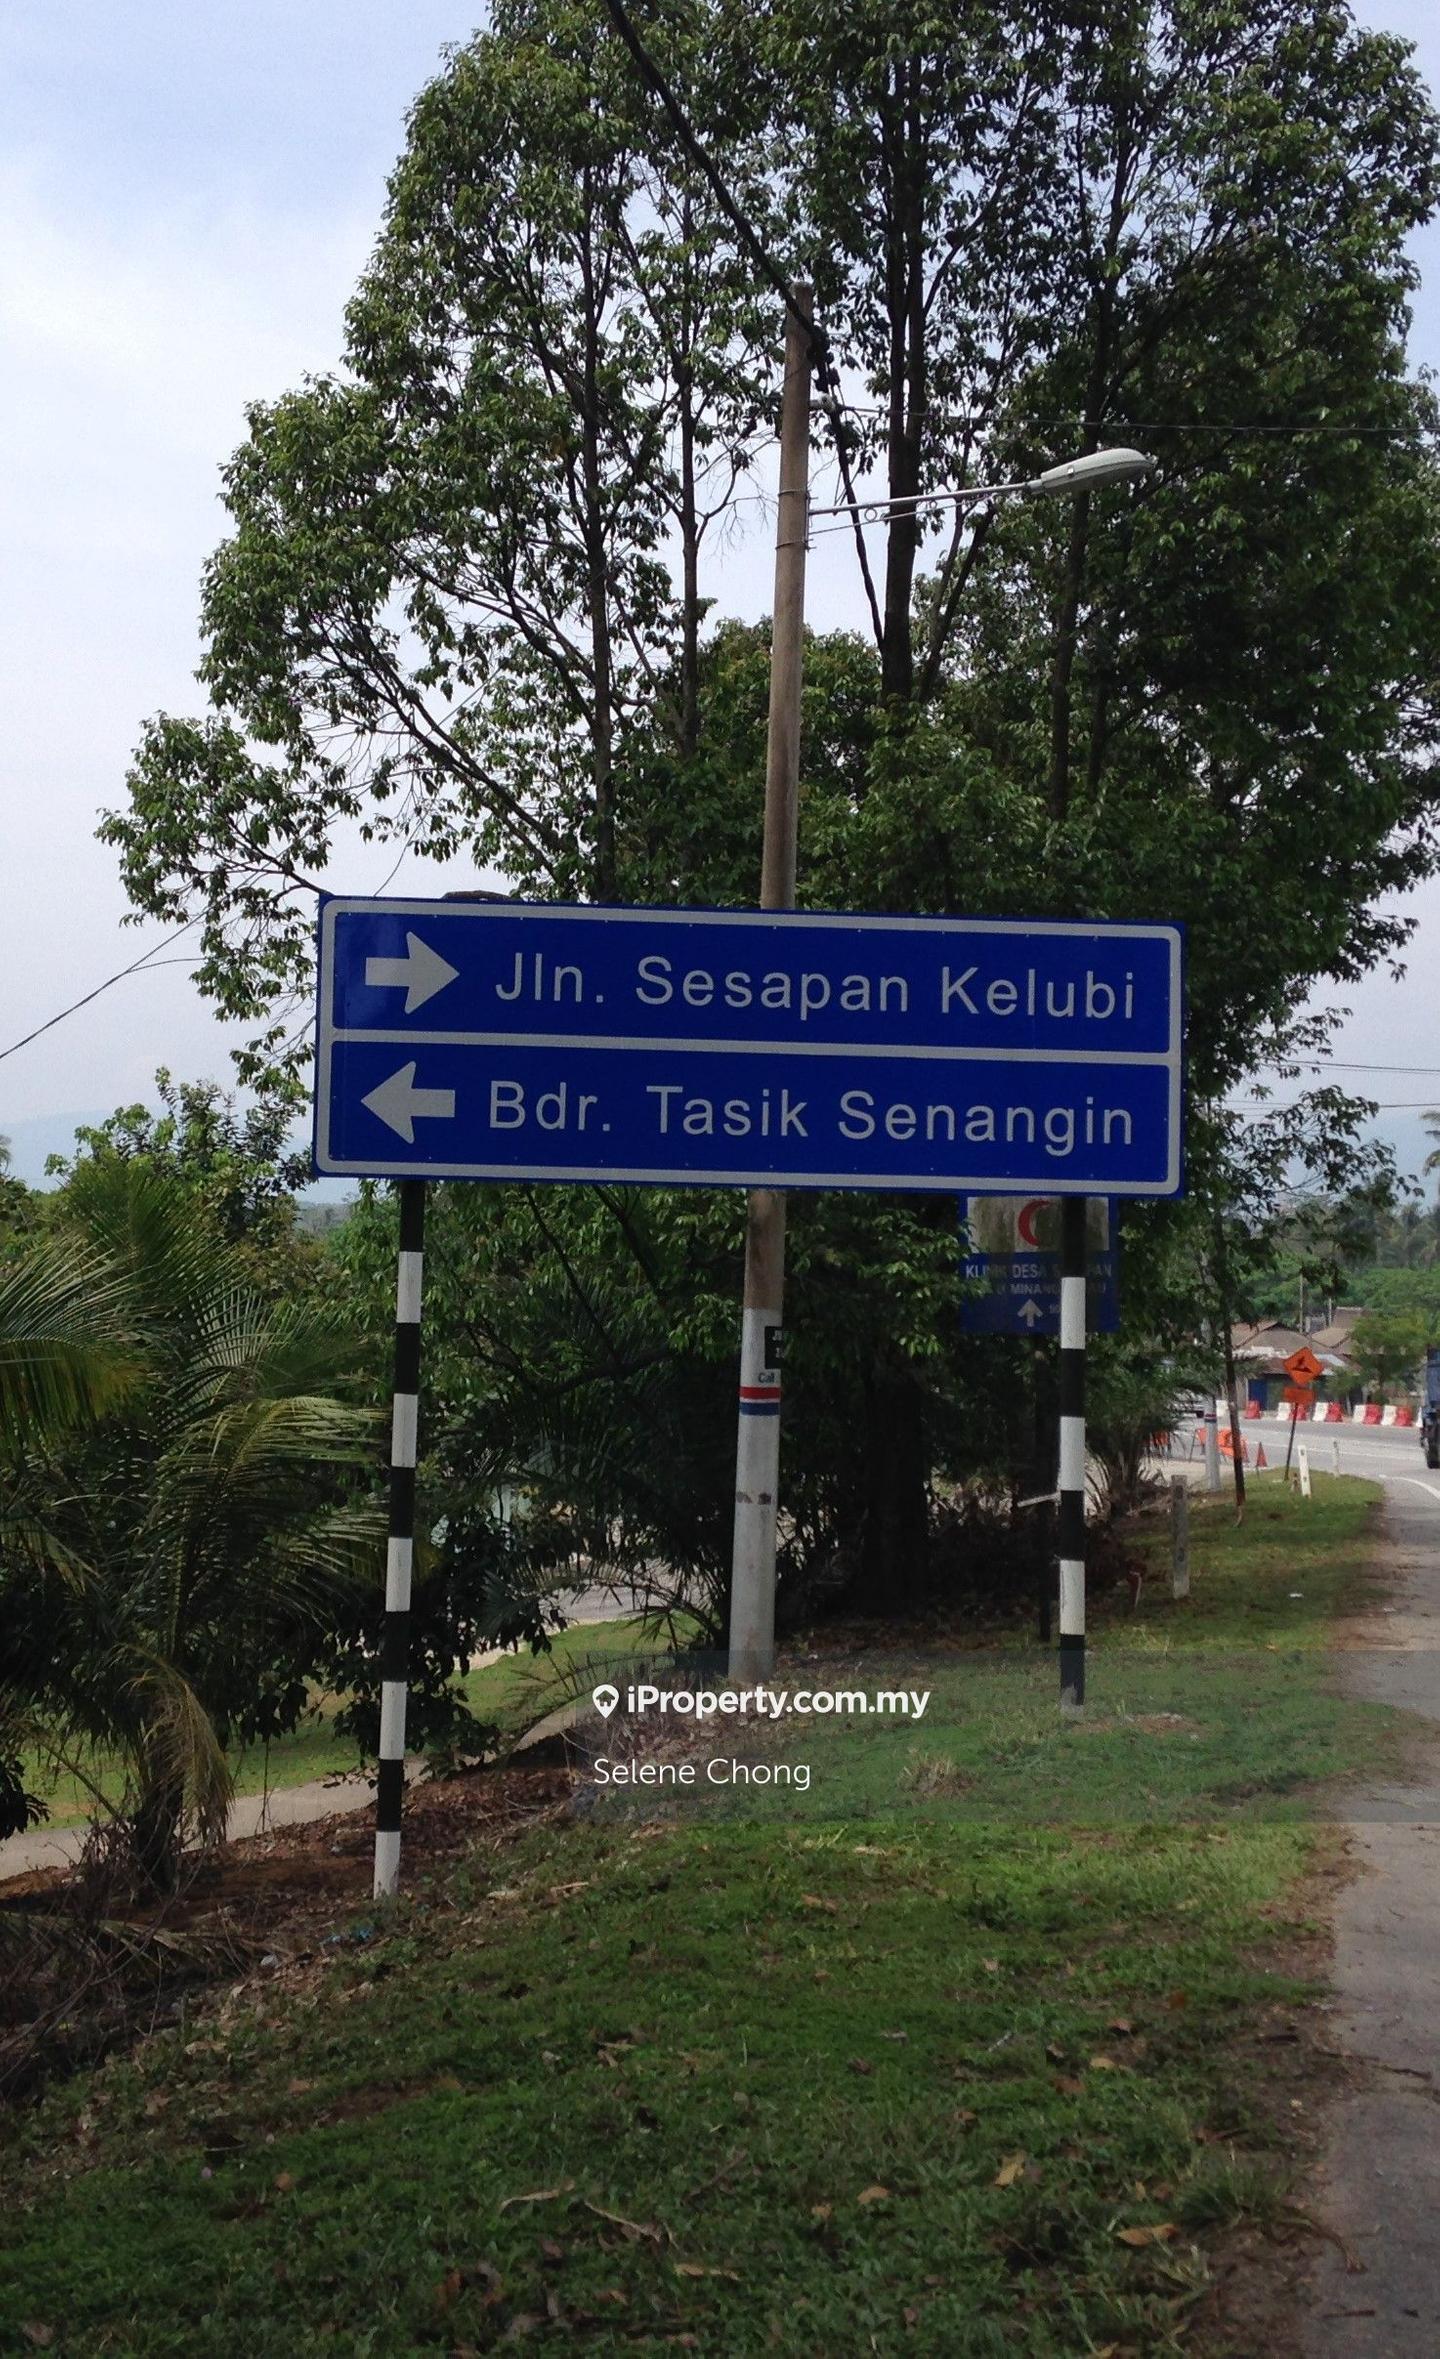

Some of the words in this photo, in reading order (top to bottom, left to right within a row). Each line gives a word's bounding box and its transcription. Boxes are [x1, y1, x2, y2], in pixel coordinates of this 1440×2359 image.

[495, 952, 604, 1003] Jln.
[636, 955, 908, 1021] Sesapan
[942, 966, 1133, 1019] Kelubi
[490, 1080, 610, 1131] Bdr.
[646, 1085, 808, 1137] Tasik
[839, 1089, 1132, 1157] Senangin
